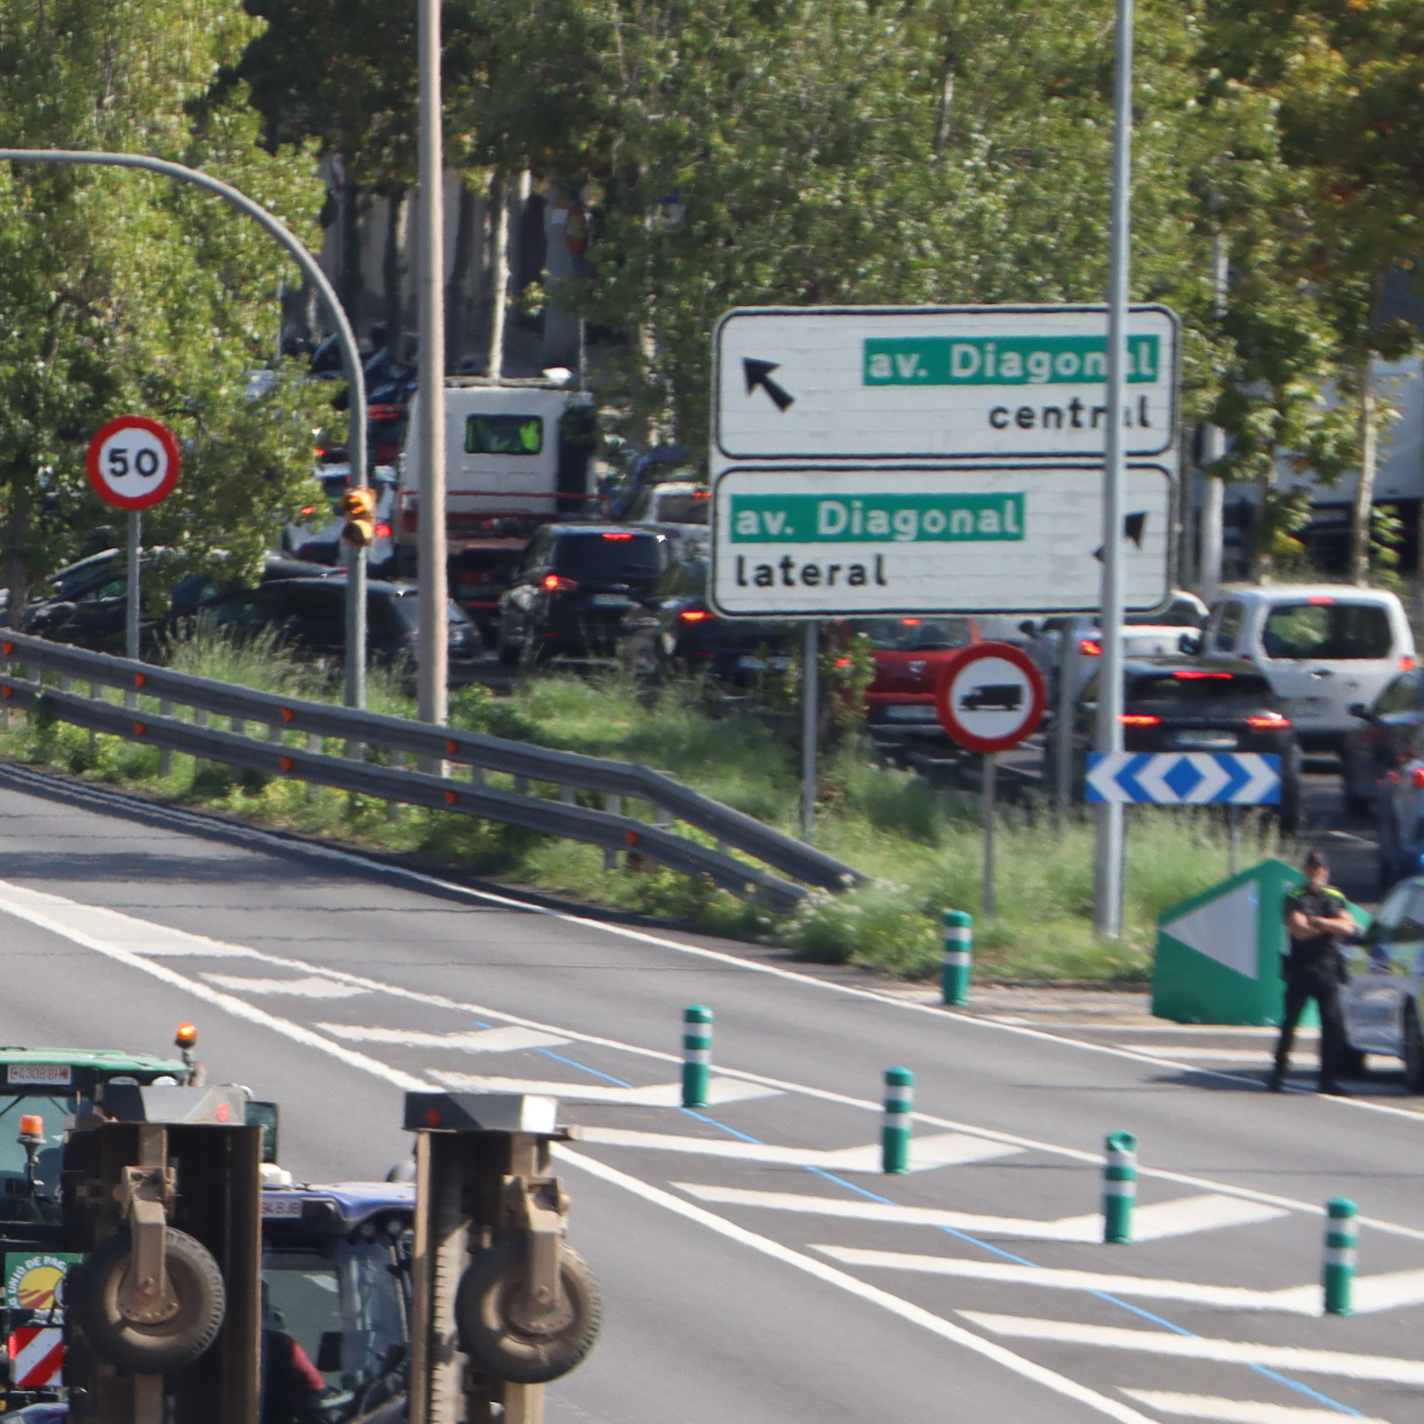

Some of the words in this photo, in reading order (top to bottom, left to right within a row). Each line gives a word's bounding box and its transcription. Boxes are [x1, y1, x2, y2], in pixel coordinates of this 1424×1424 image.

[868, 350, 928, 379] av.
[989, 395, 1151, 429] centrl
[108, 447, 159, 477] 50
[735, 508, 794, 535] av.
[817, 499, 1020, 541] Diagonal
[735, 553, 887, 587] lateral
